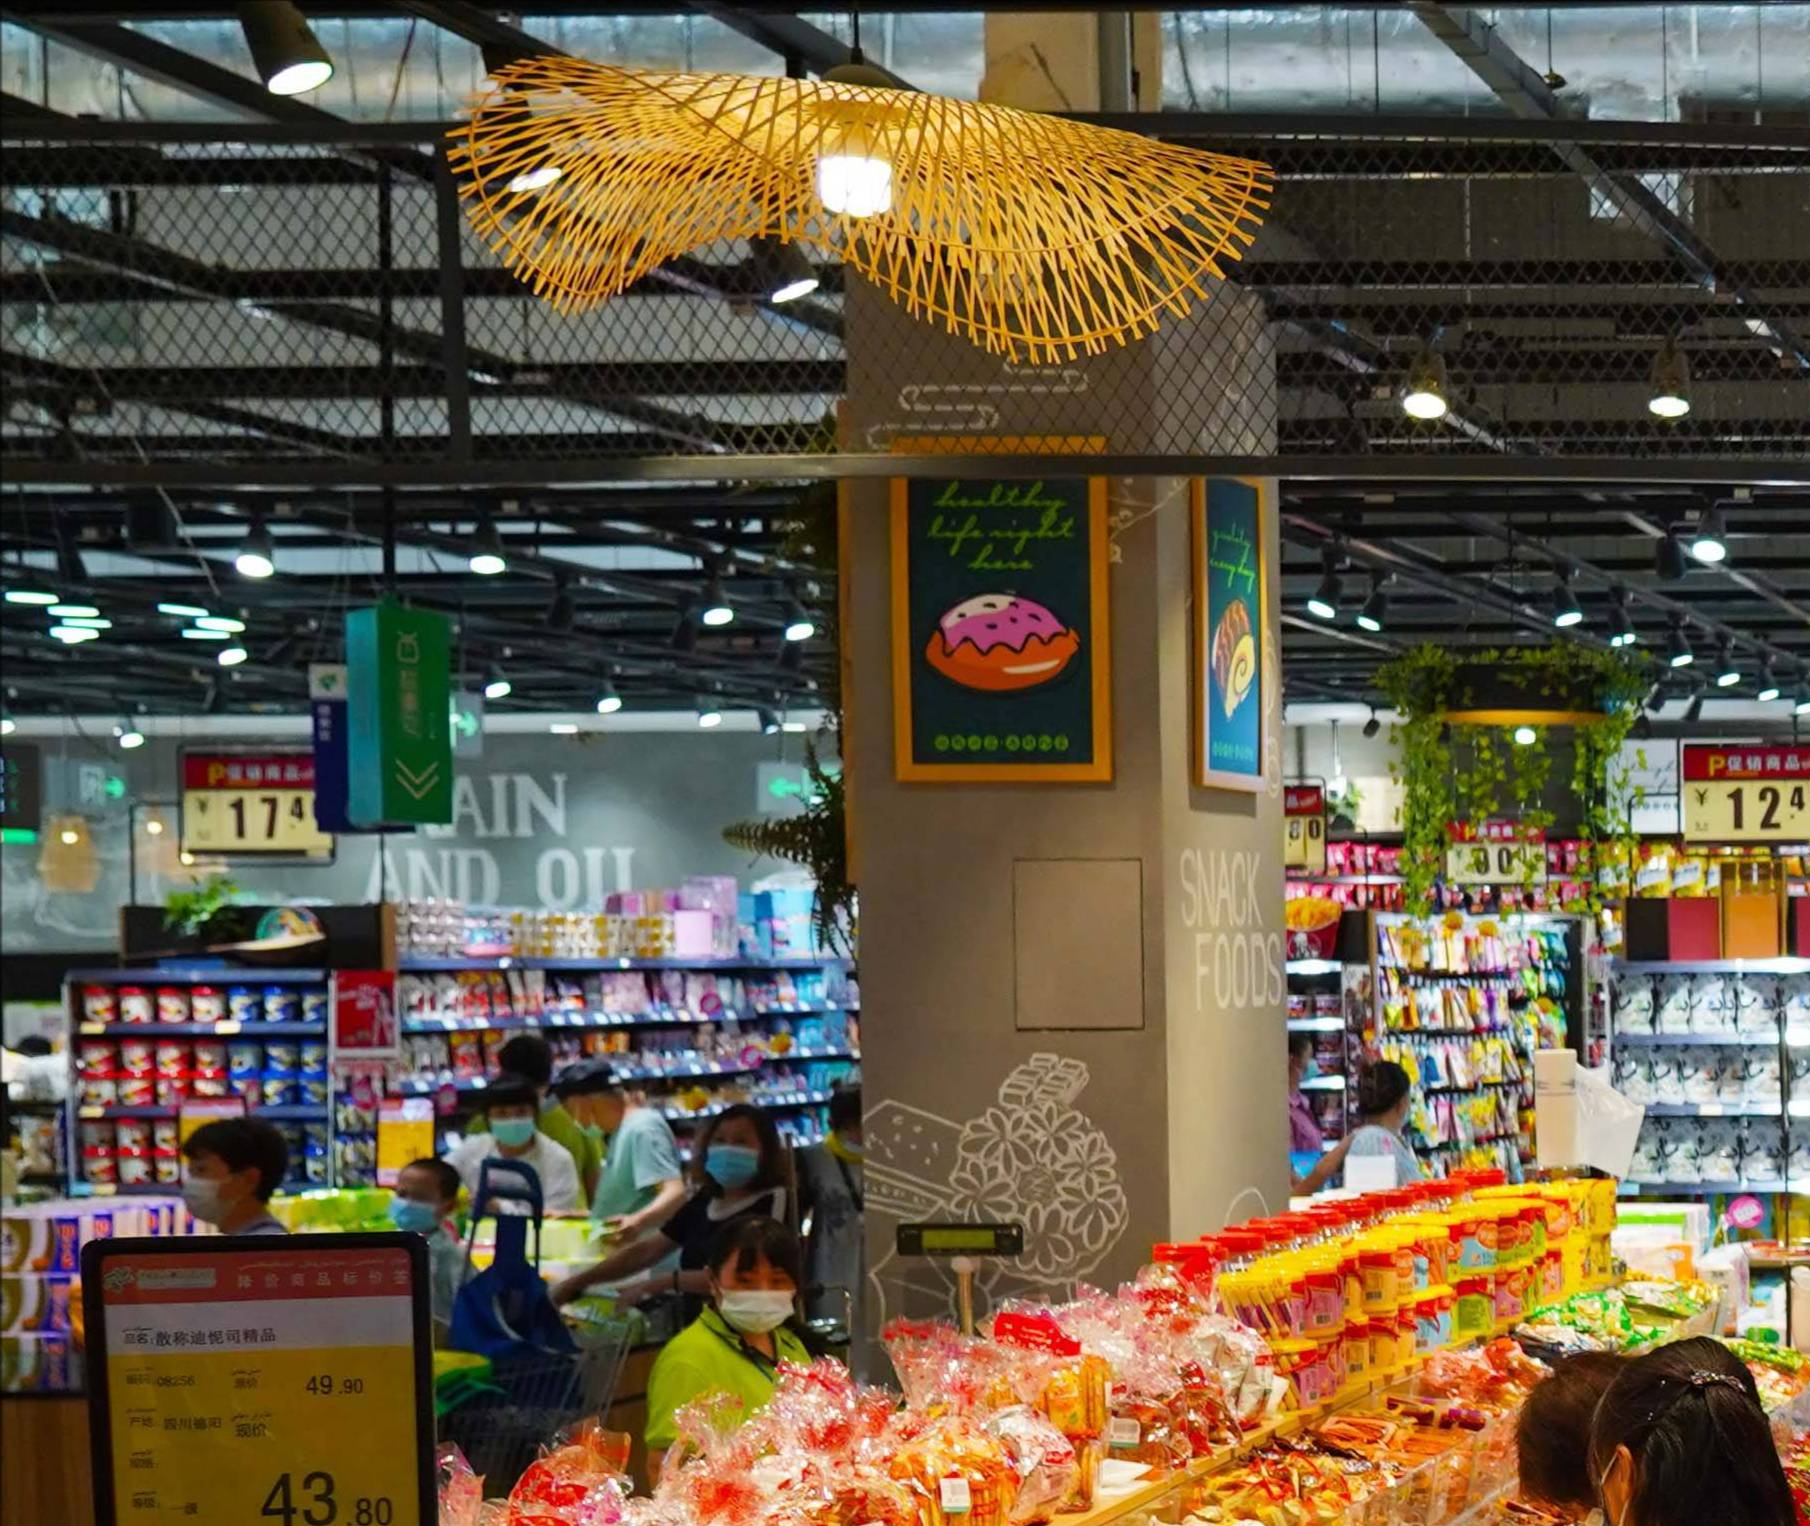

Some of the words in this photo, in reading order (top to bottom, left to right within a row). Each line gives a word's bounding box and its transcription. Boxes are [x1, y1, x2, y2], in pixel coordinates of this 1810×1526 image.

[364, 849, 500, 906] AND
[1179, 848, 1263, 928] SNACK
[1193, 933, 1283, 1010] FOODS
